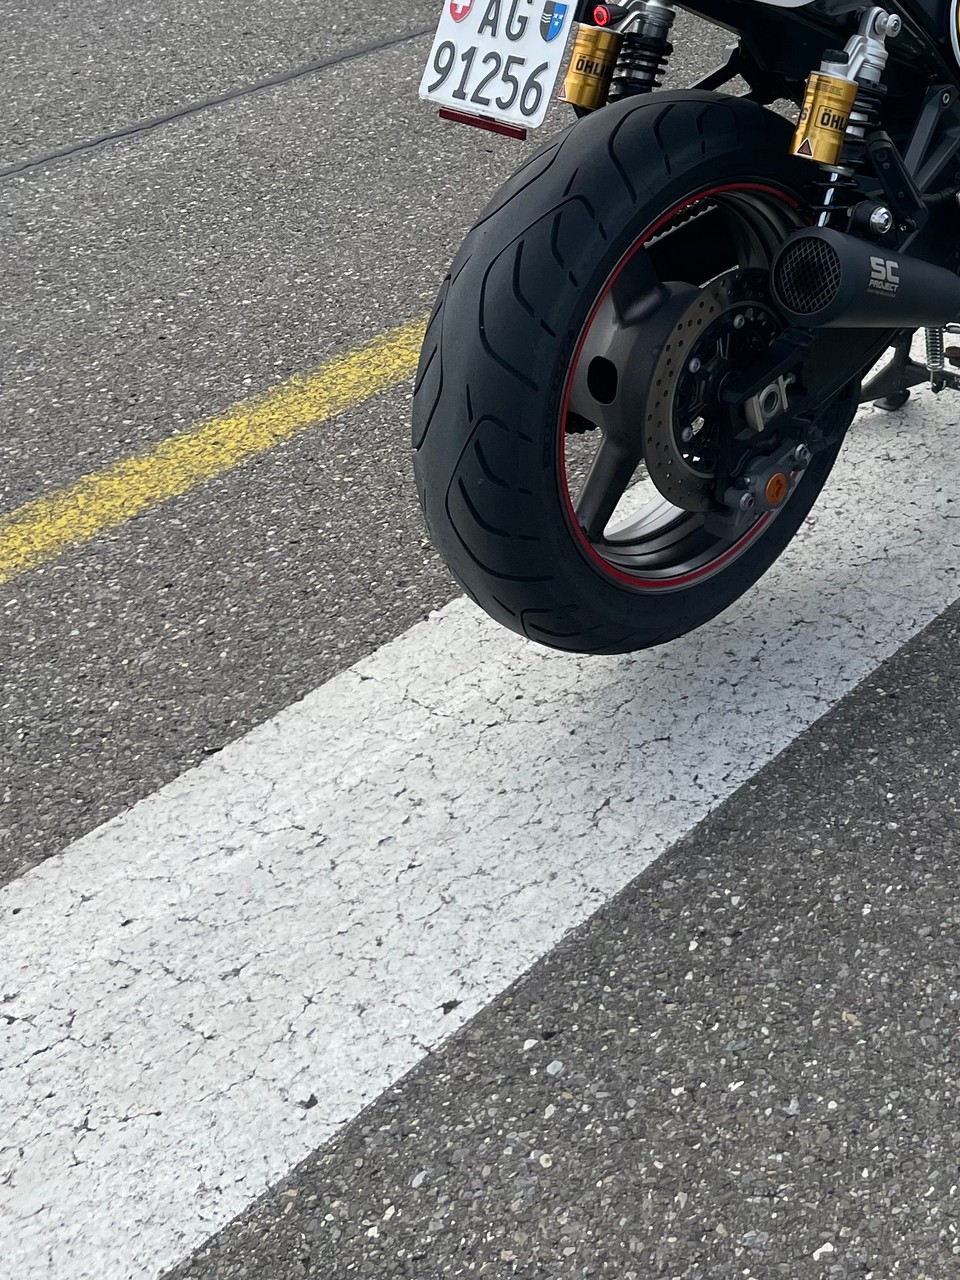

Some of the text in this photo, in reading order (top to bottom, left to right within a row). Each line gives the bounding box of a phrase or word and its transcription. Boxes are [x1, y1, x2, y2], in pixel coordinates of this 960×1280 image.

[427, 40, 549, 117] 91256
[576, 55, 608, 78] ÖHLI
[870, 256, 900, 284] SC
[868, 279, 899, 293] PROJECT
